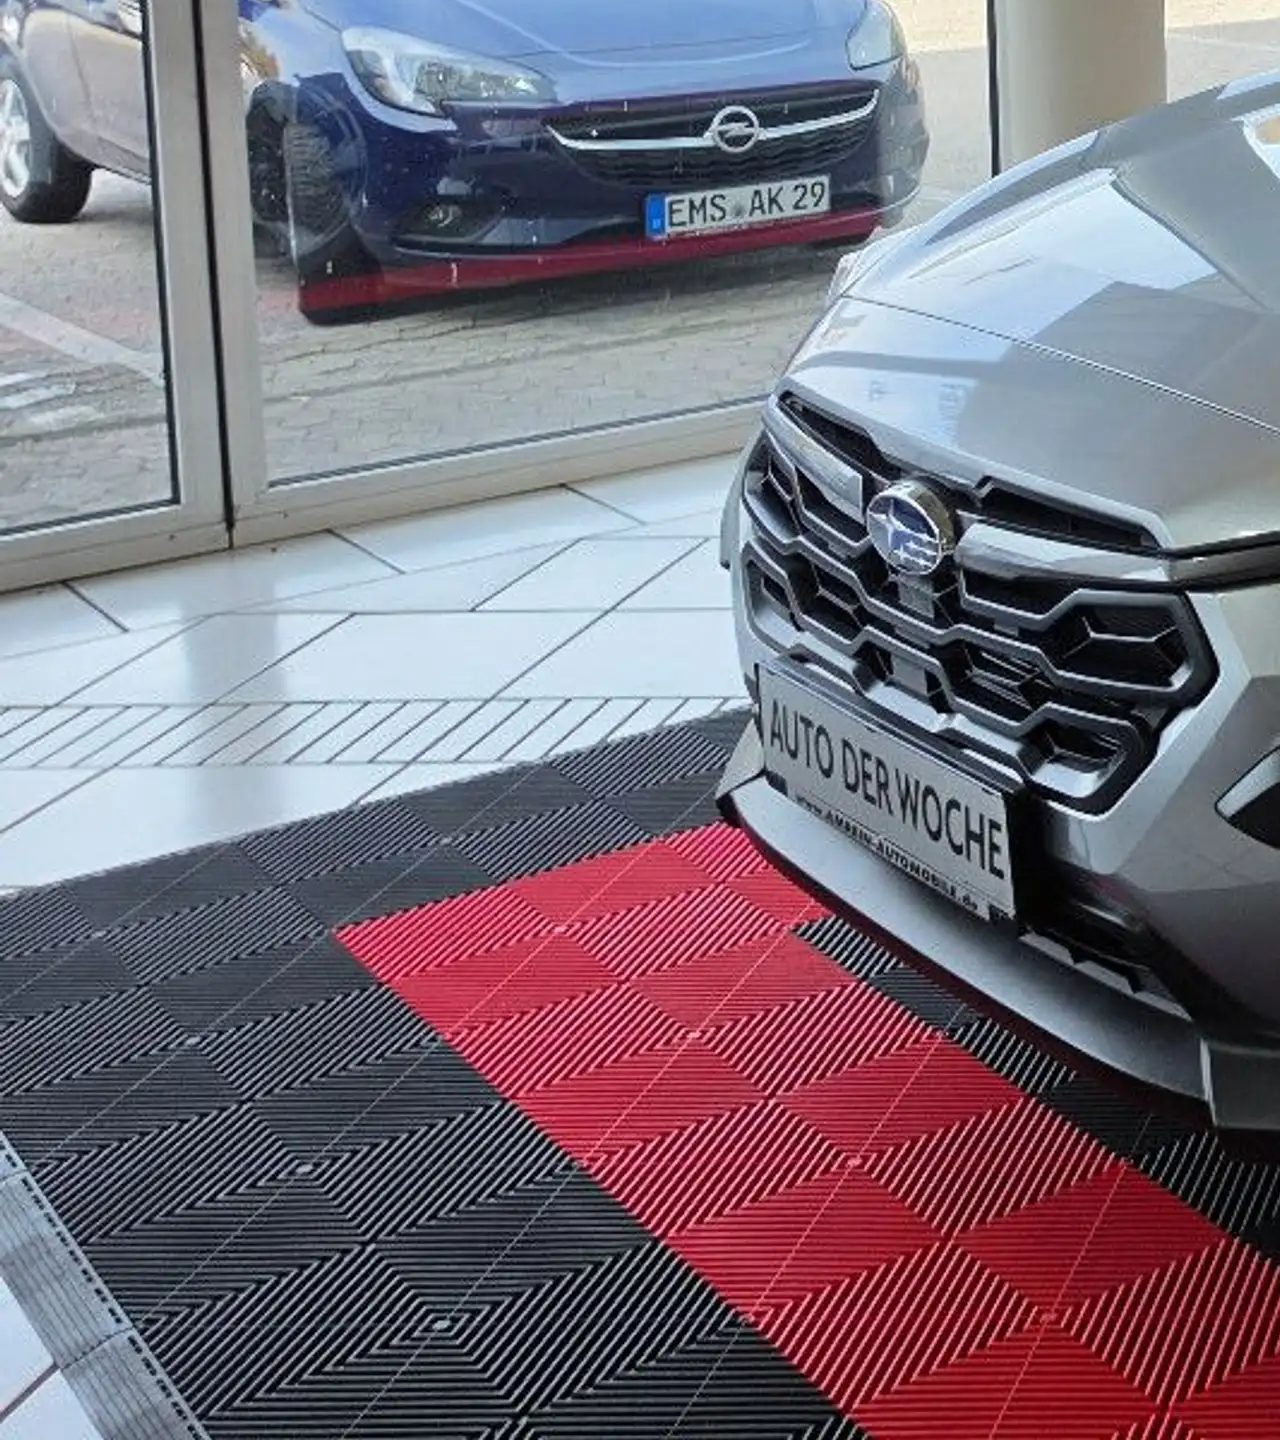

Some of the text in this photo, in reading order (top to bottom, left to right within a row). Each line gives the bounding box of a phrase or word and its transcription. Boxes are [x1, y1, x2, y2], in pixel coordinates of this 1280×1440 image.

[669, 181, 825, 227] EMS AK 29
[770, 699, 1005, 880] AUTO DER WOCHE
